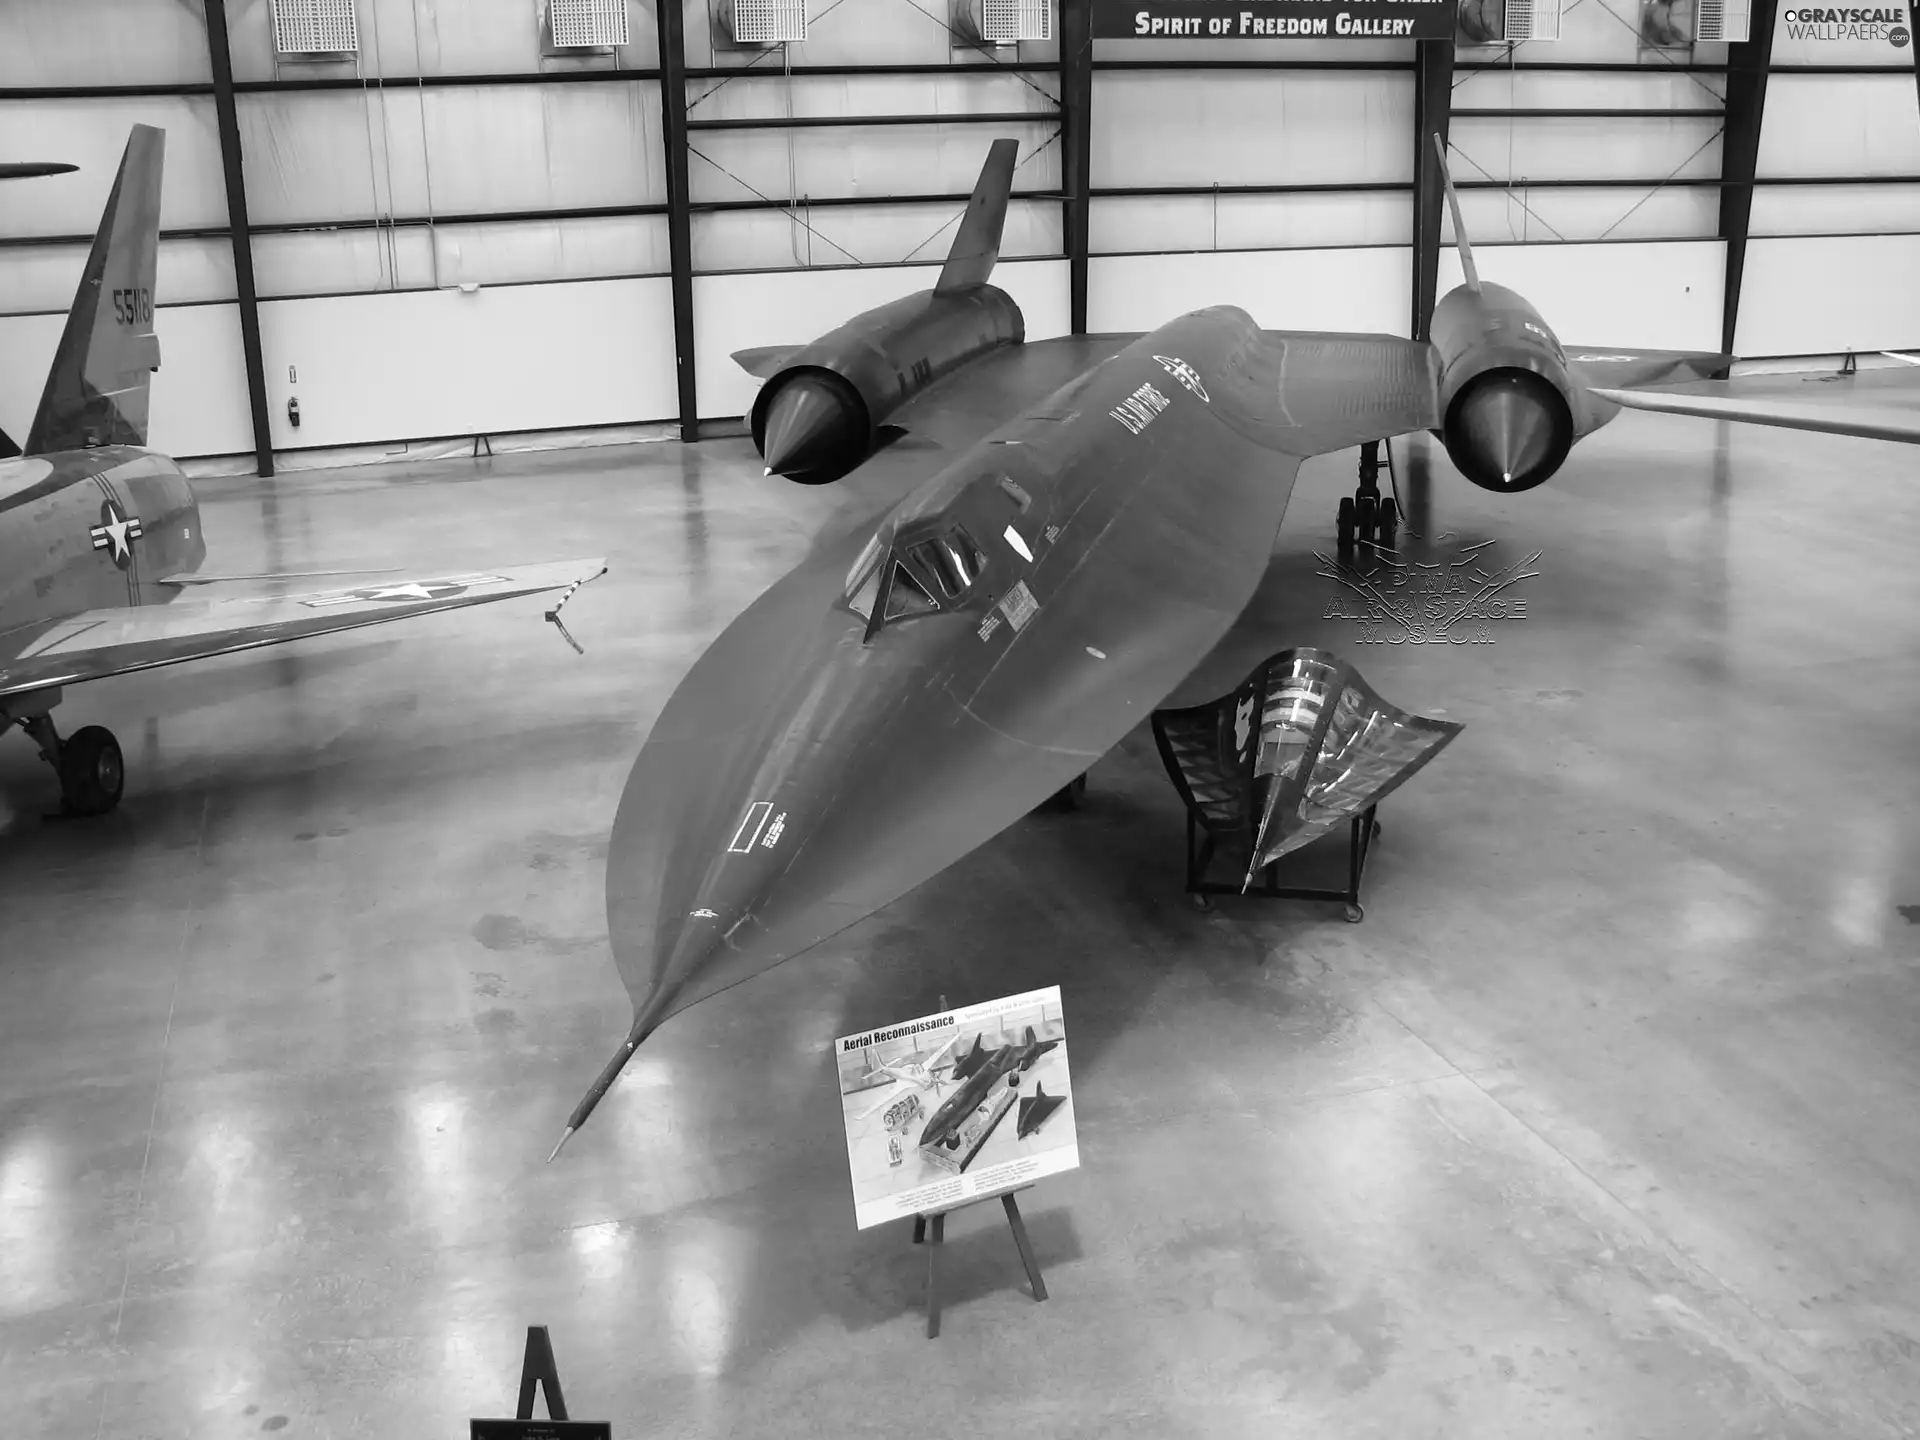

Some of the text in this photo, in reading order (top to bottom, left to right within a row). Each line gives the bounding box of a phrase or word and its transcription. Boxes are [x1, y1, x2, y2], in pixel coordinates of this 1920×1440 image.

[1135, 11, 1201, 34] SPIRIT
[1239, 12, 1327, 34] FREEDOM
[1335, 12, 1415, 34] GALLERY
[112, 288, 151, 326] 55118
[843, 1015, 955, 1052] Aerial Reconnaissance
